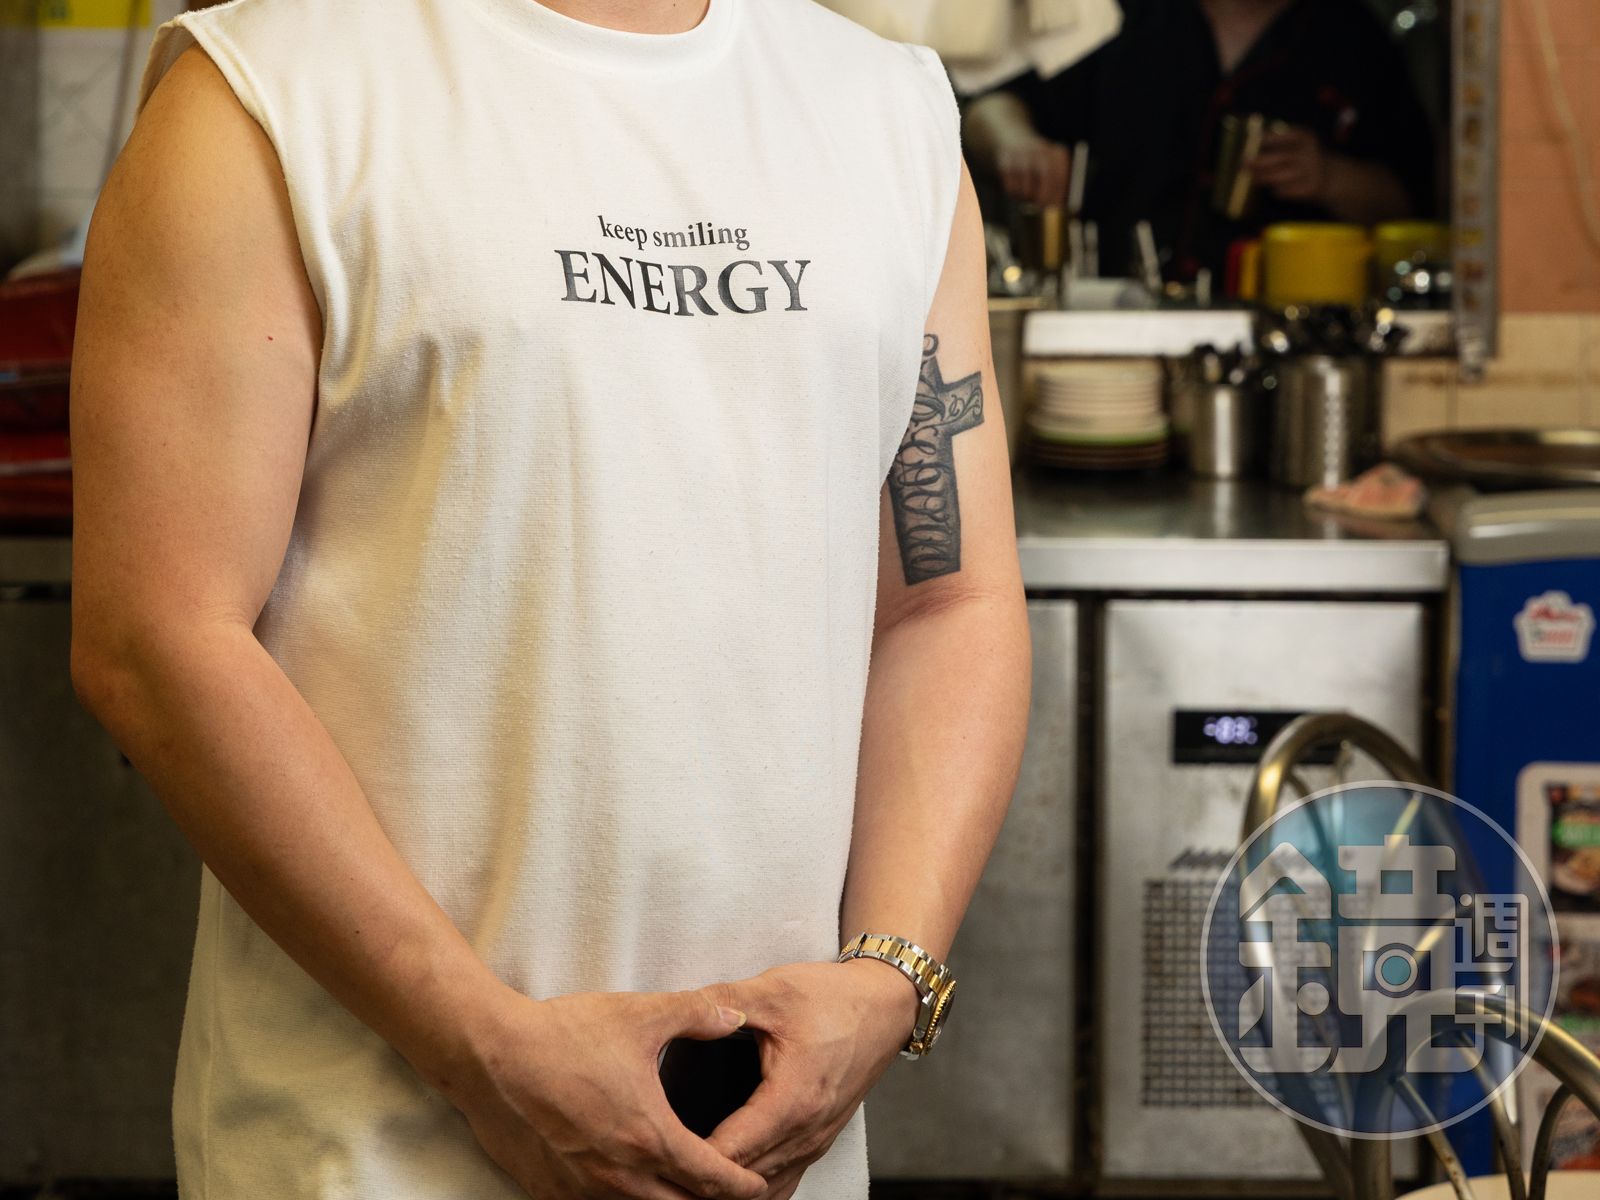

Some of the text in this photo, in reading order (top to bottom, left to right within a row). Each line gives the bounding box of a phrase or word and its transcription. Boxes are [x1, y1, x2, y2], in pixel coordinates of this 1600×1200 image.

[598, 215, 750, 251] keep smiling
[554, 249, 811, 317] ENERGY
